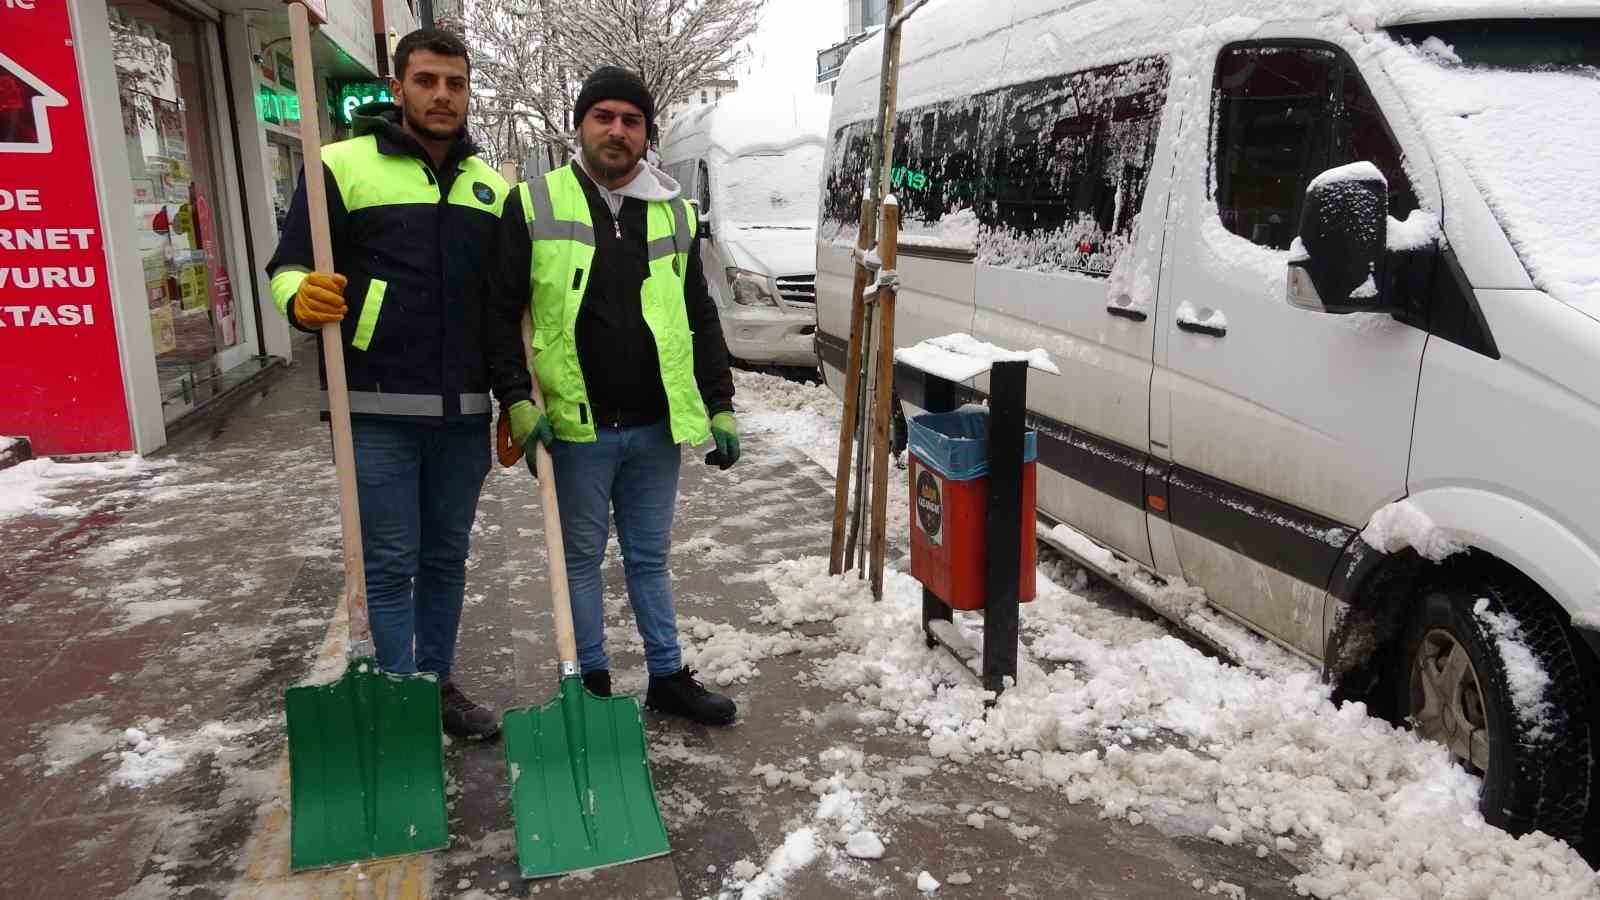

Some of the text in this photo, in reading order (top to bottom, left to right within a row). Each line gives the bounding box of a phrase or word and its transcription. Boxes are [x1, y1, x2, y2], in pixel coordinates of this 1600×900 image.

[0, 189, 42, 211] DE
[0, 228, 95, 250] RNET
[0, 304, 95, 327] TASI
